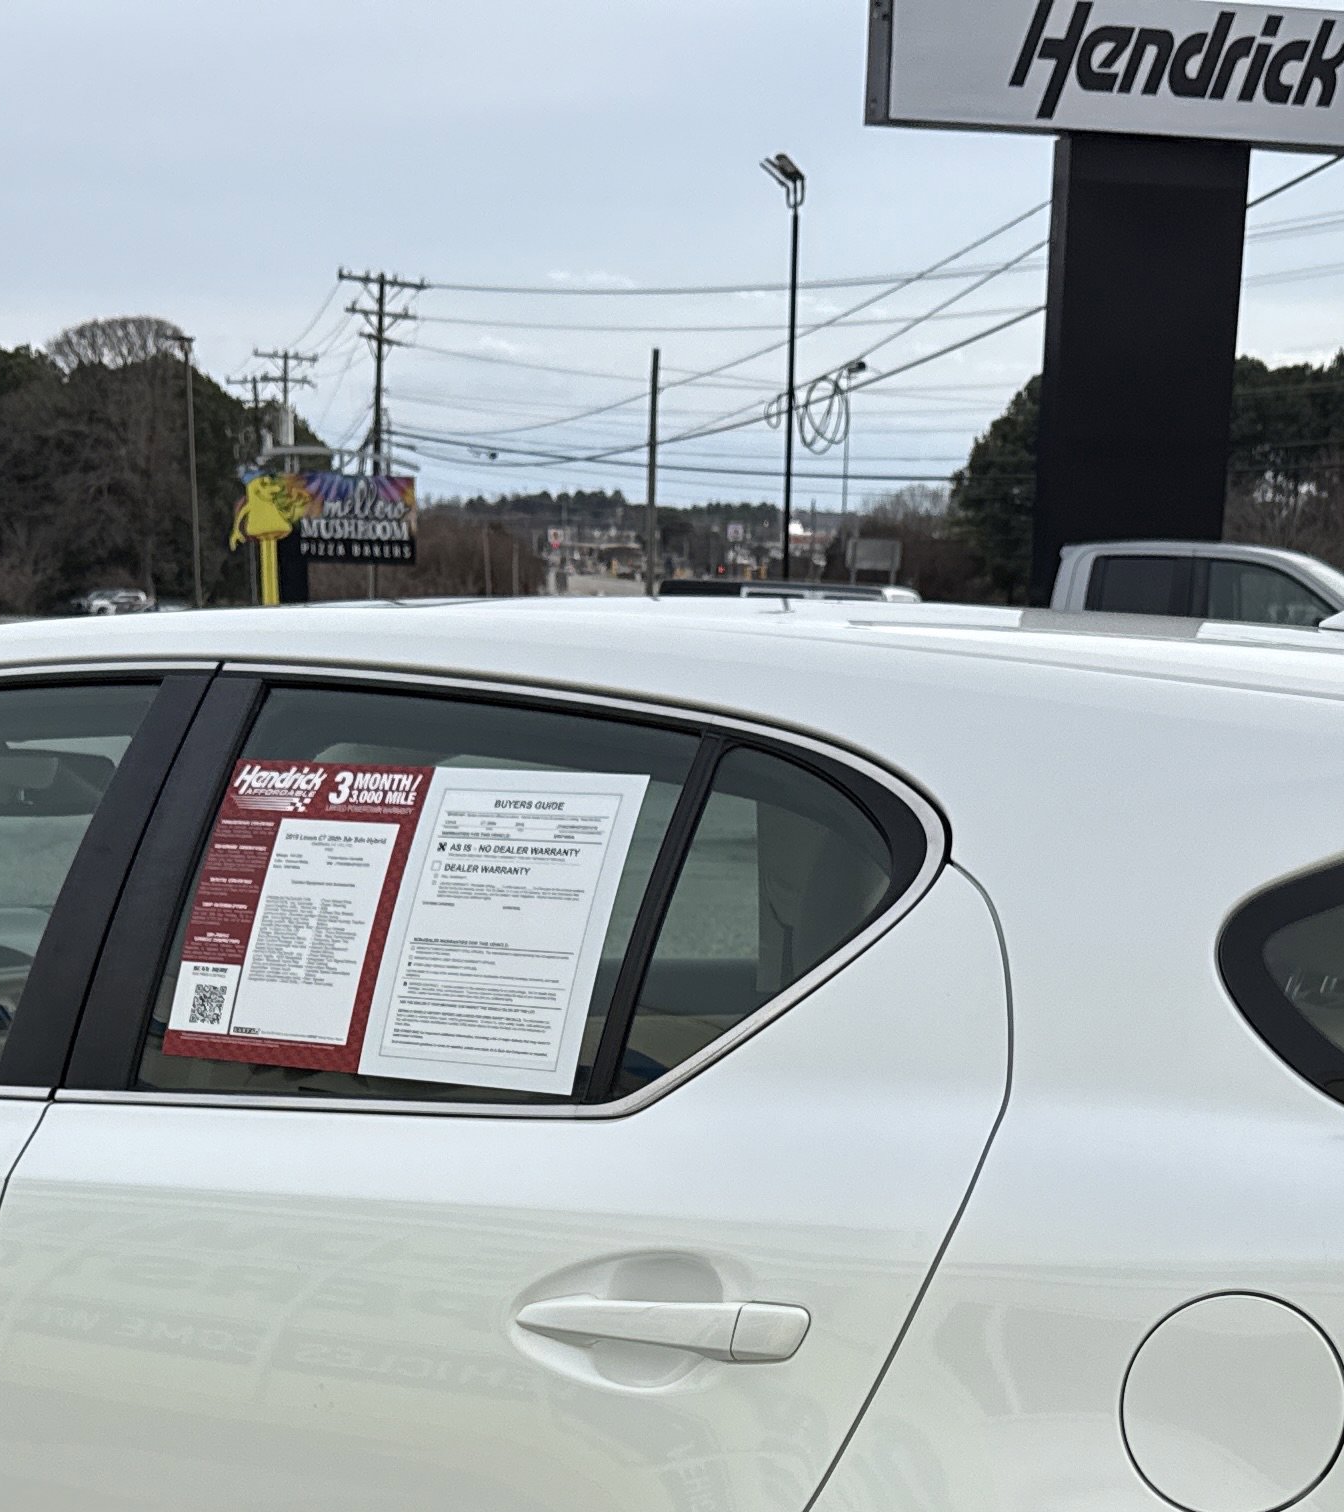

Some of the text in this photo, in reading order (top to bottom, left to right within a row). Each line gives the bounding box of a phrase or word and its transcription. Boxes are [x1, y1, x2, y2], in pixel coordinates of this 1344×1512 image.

[323, 480, 410, 519] mellow
[301, 518, 410, 541] MUSHROOM
[300, 541, 412, 559] PIZZA BAKERS
[233, 764, 328, 795] Hendrick
[328, 771, 423, 805] 3 MONTH/
[244, 788, 317, 797] AFFORDABLE
[349, 790, 417, 806] 3,000 MILE
[494, 799, 565, 811] BUYERS GUIDE
[450, 843, 462, 851] AS
[463, 843, 472, 852] IS
[478, 844, 492, 853] NO
[493, 845, 529, 855] DEALER
[530, 846, 580, 857] WARRANTY
[443, 863, 531, 875] DEALER WARRANTY
